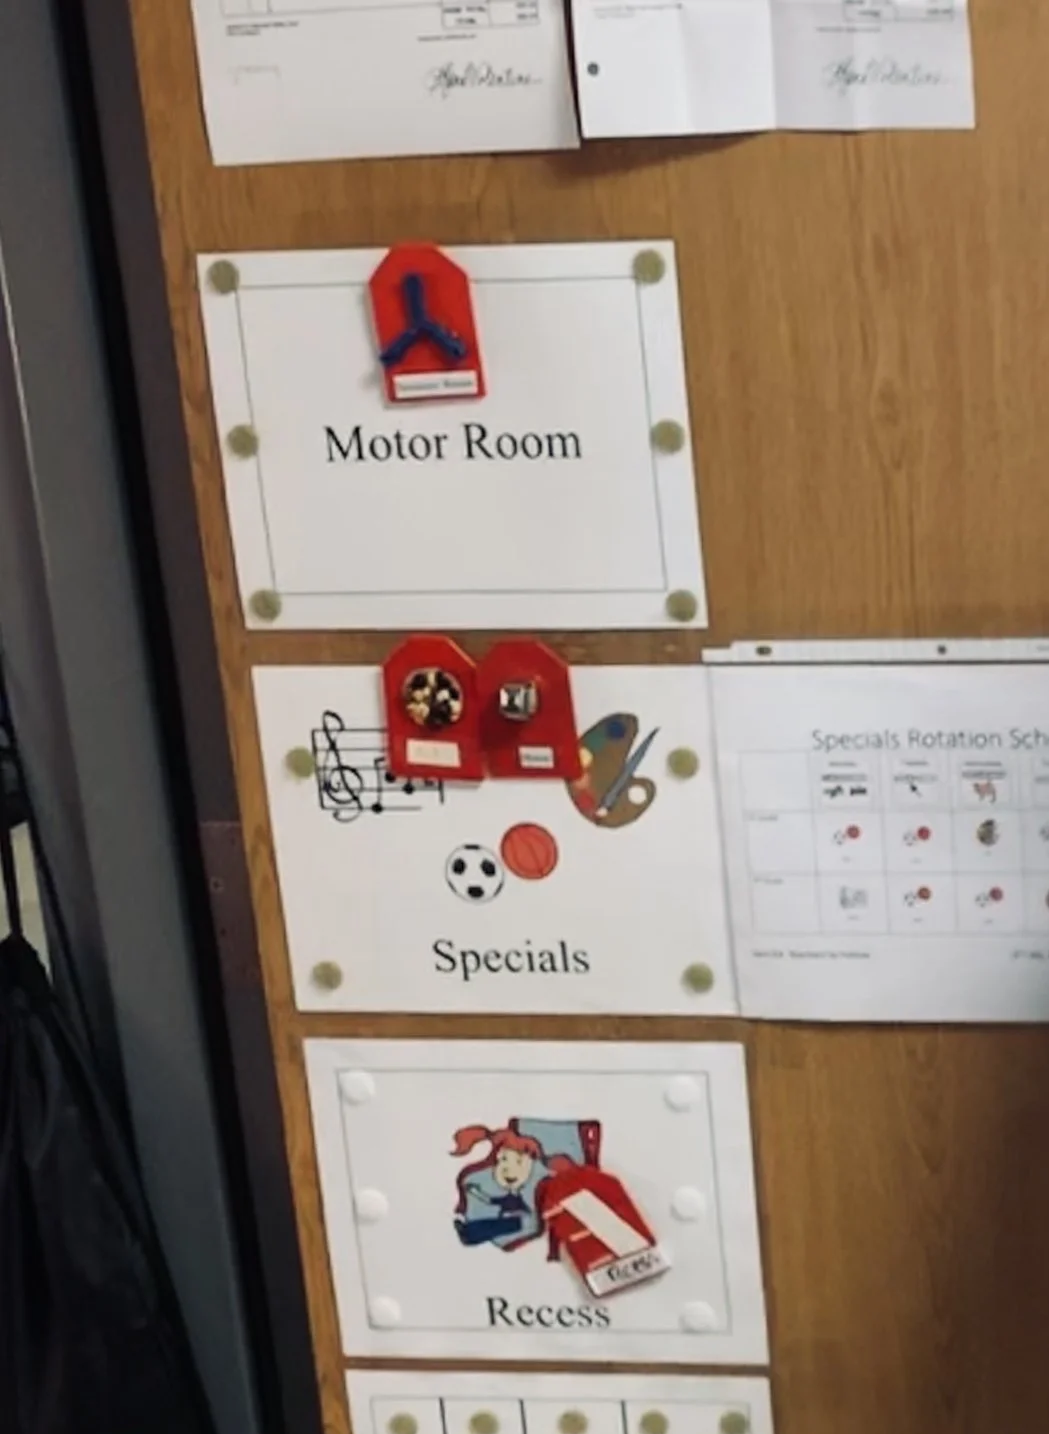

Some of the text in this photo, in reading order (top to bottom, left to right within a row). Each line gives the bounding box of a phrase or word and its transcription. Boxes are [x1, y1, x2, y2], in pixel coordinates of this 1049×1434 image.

[323, 422, 582, 463] Motor Room
[811, 729, 902, 755] Specials
[907, 729, 1003, 751] Rotation
[431, 939, 591, 982] Specials
[486, 1296, 612, 1328] Recess
